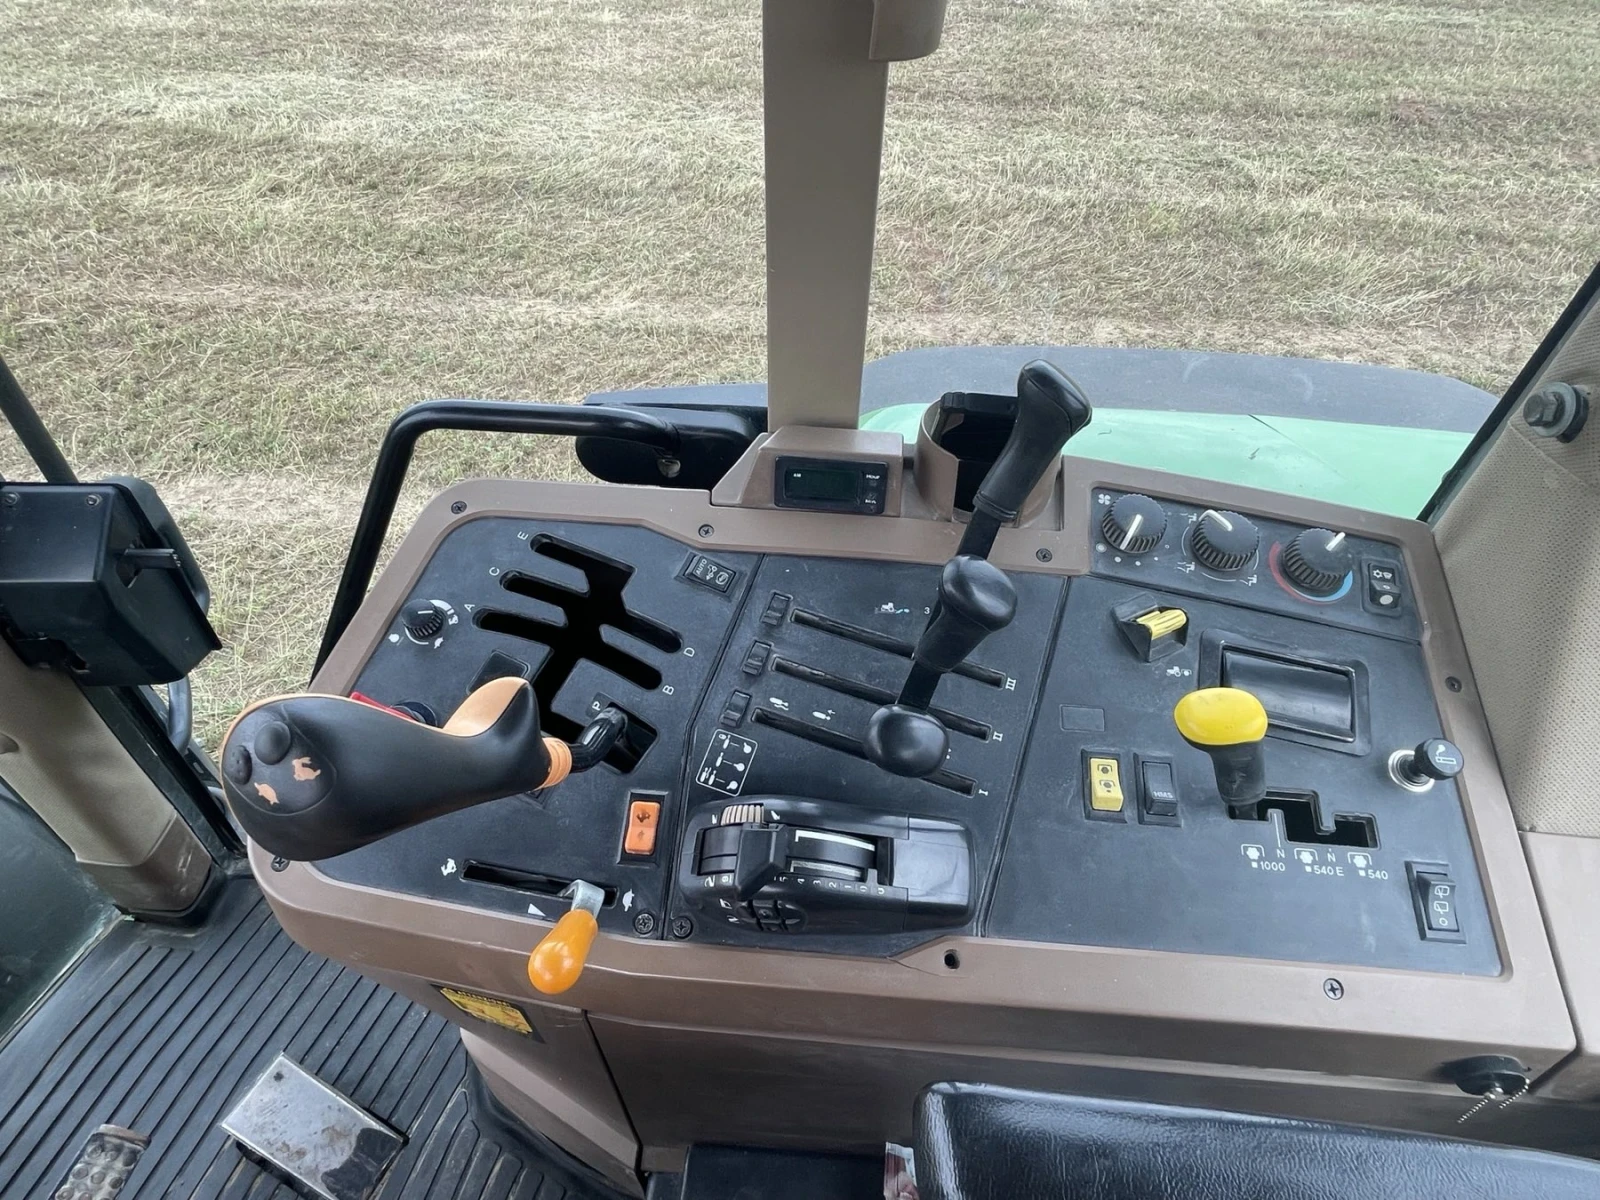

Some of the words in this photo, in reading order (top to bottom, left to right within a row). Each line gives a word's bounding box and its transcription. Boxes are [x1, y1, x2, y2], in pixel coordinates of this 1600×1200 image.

[517, 531, 529, 541] E
[489, 567, 500, 577] C
[695, 558, 708, 575] AUTO
[464, 603, 476, 613] A
[923, 606, 931, 615] 3
[683, 646, 696, 658] D
[662, 684, 675, 696] B
[591, 700, 601, 711] P
[1276, 849, 1285, 859] N
[1327, 852, 1336, 863] N
[1259, 861, 1286, 872] 1000
[1313, 865, 1334, 876] 540
[1336, 867, 1345, 877] E
[1367, 870, 1389, 880] 540
